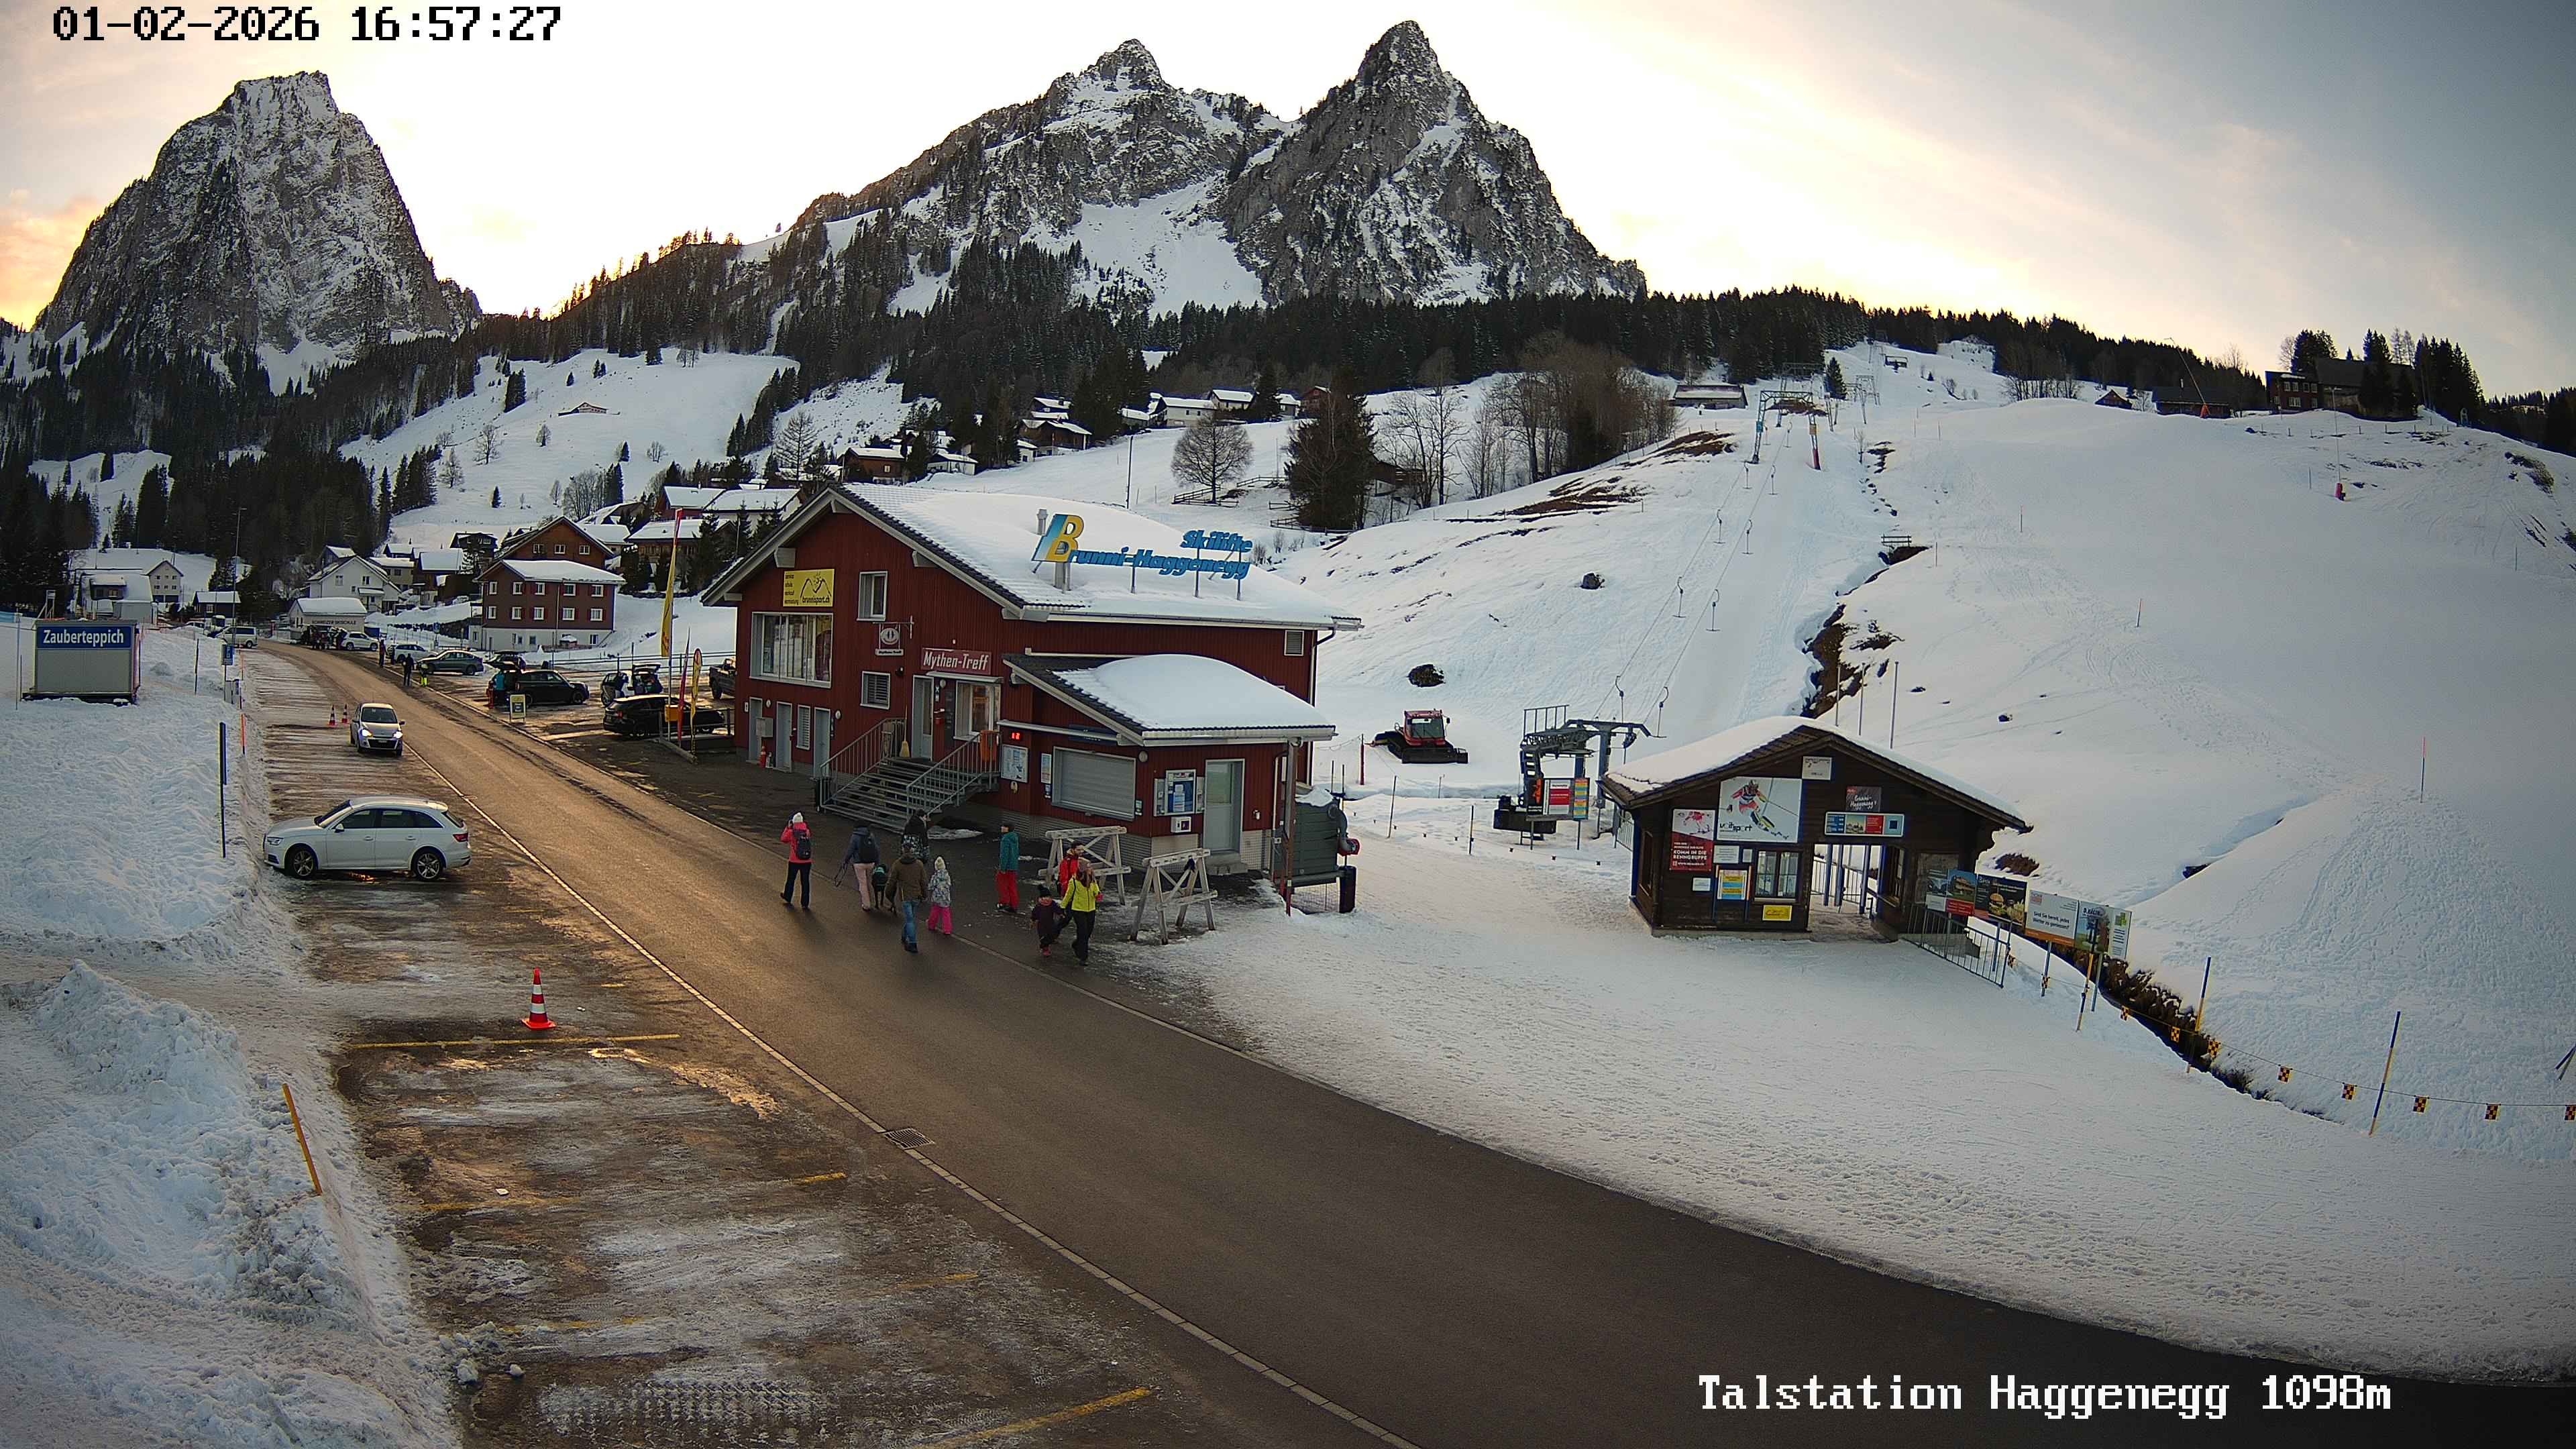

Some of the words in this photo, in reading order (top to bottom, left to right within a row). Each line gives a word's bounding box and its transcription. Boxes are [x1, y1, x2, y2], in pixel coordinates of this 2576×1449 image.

[1032, 514, 1251, 579] Brunni-Haggenegg
[1180, 530, 1252, 553] Skilifte
[43, 629, 123, 647] Zauberteppich
[923, 651, 989, 670] Mythen-Treff
